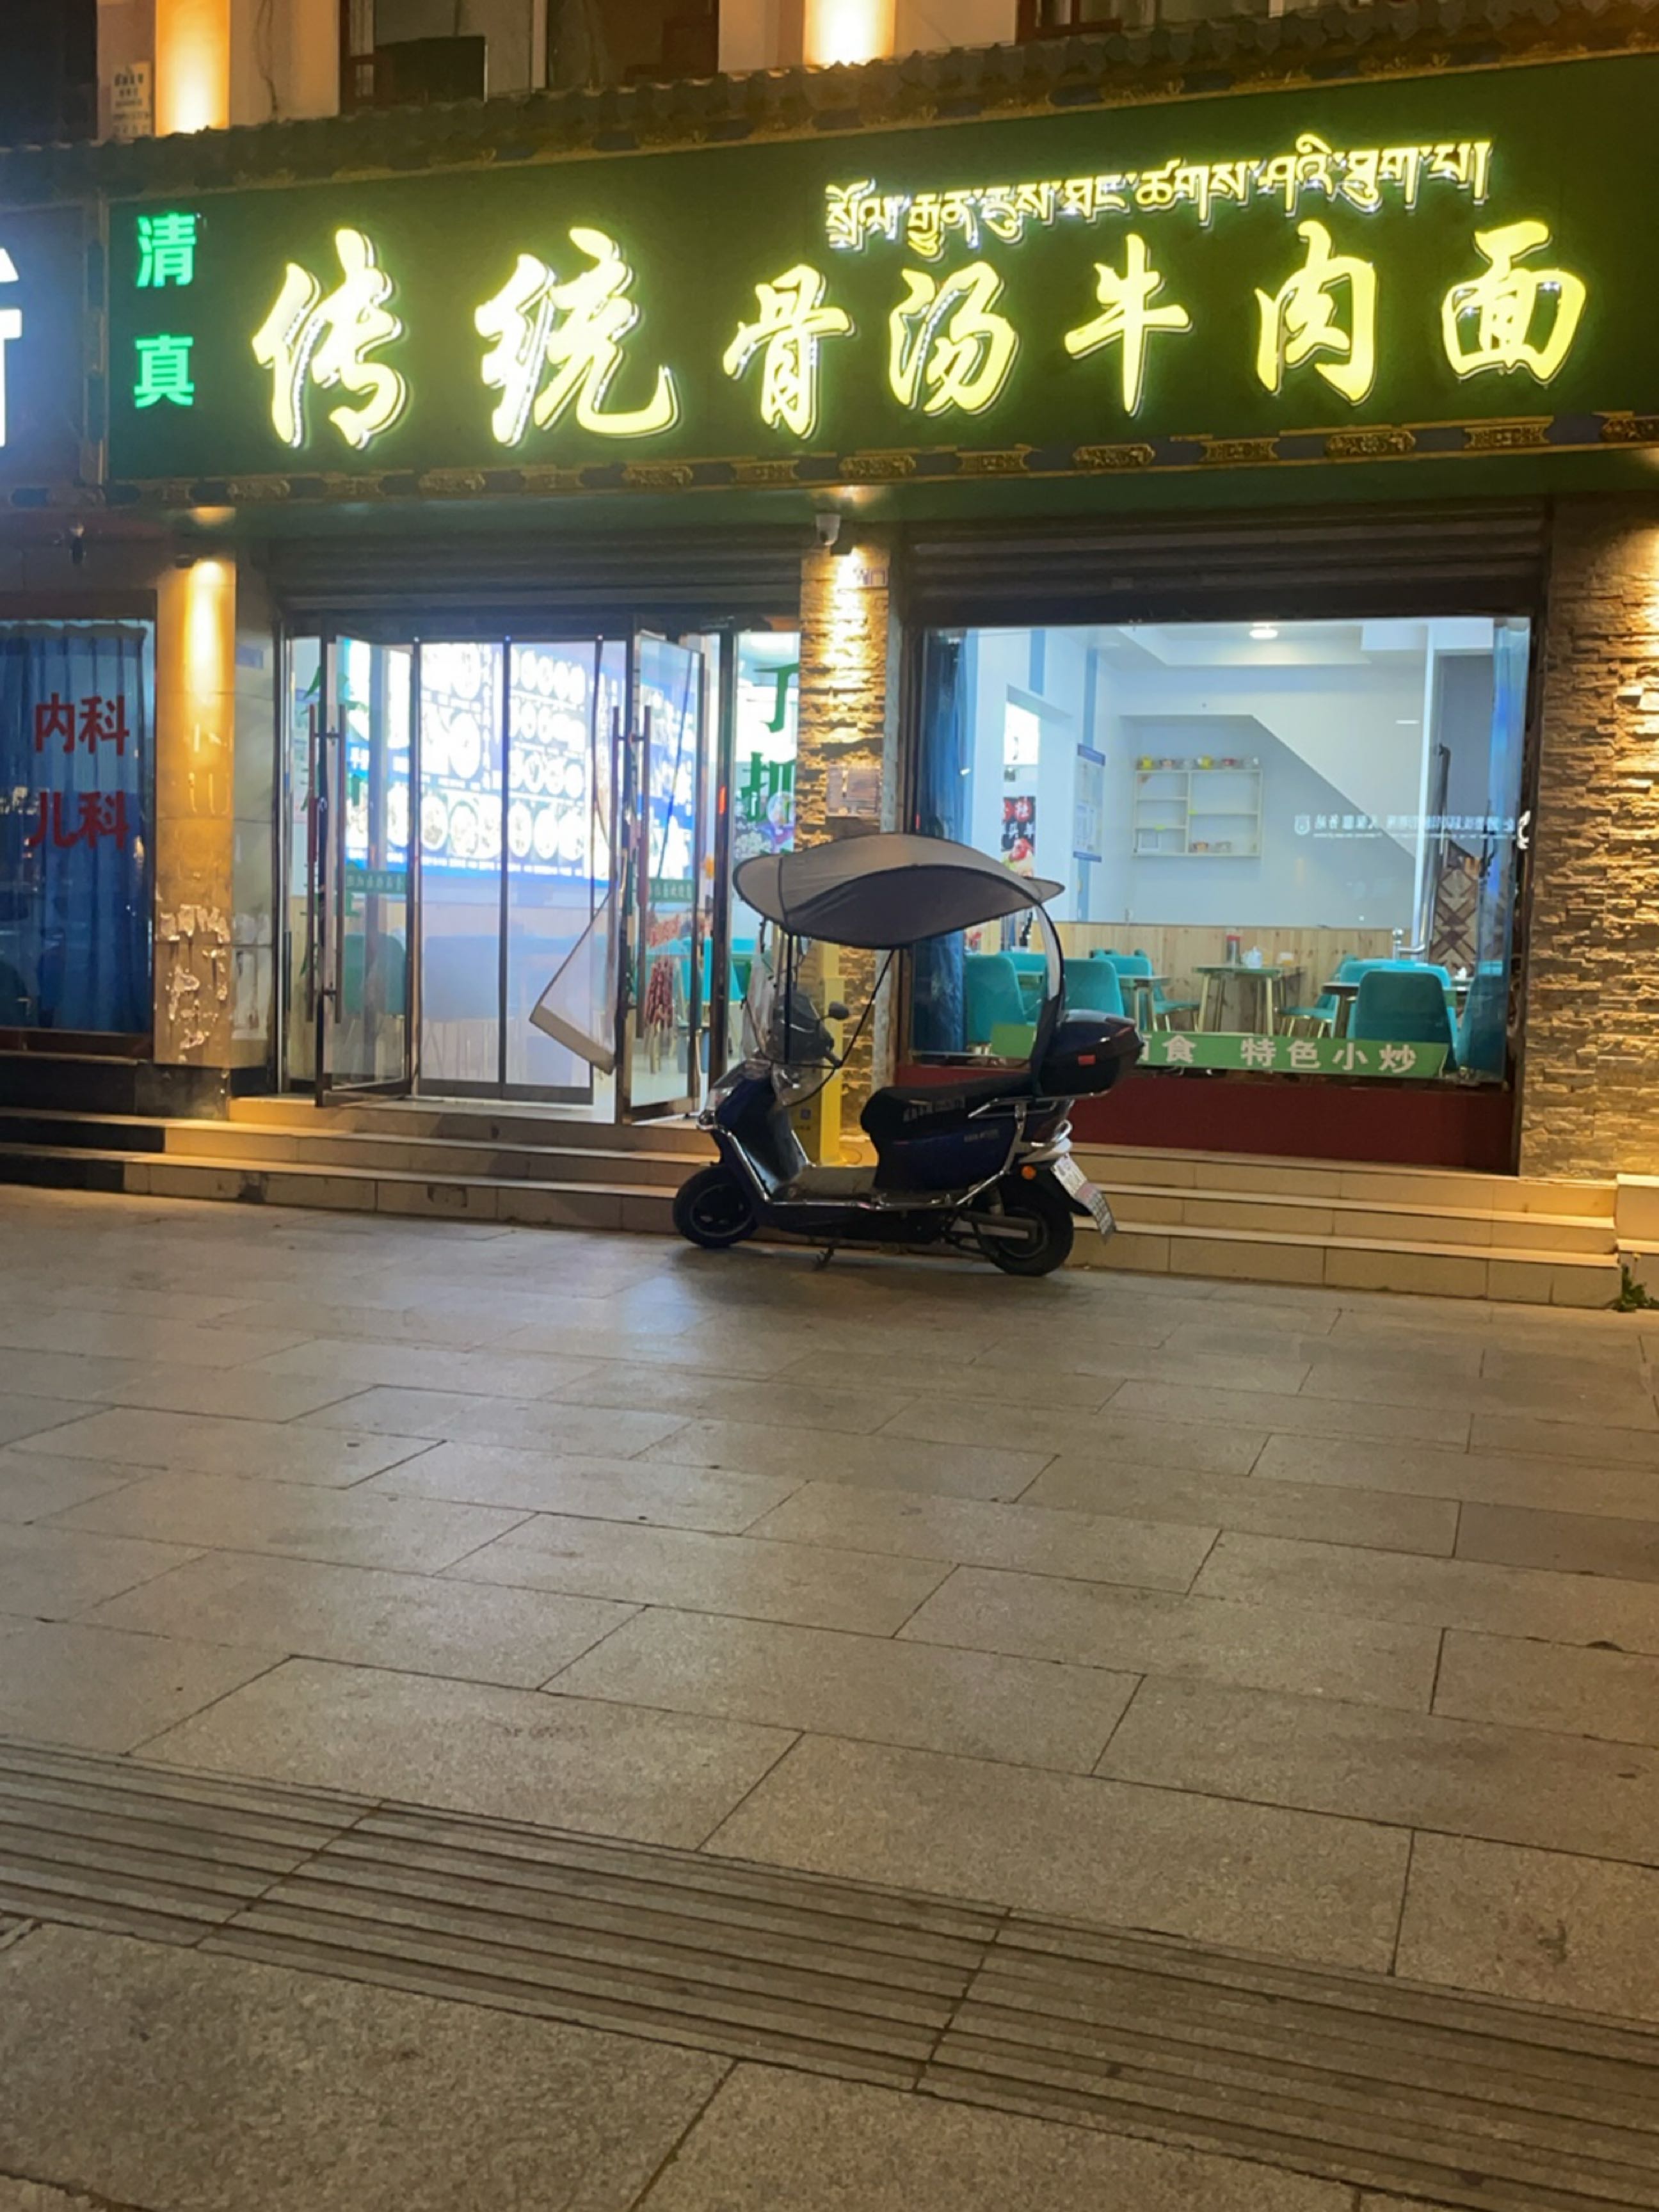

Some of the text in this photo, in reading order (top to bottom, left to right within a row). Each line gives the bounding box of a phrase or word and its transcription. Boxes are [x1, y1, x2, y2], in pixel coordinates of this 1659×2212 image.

[134, 212, 196, 409] 清真
[252, 221, 1587, 448] 传统骨汤牛肉面
[35, 693, 130, 755] 内科
[29, 790, 129, 850] 儿科
[1240, 1038, 1417, 1073] 特色小炒
